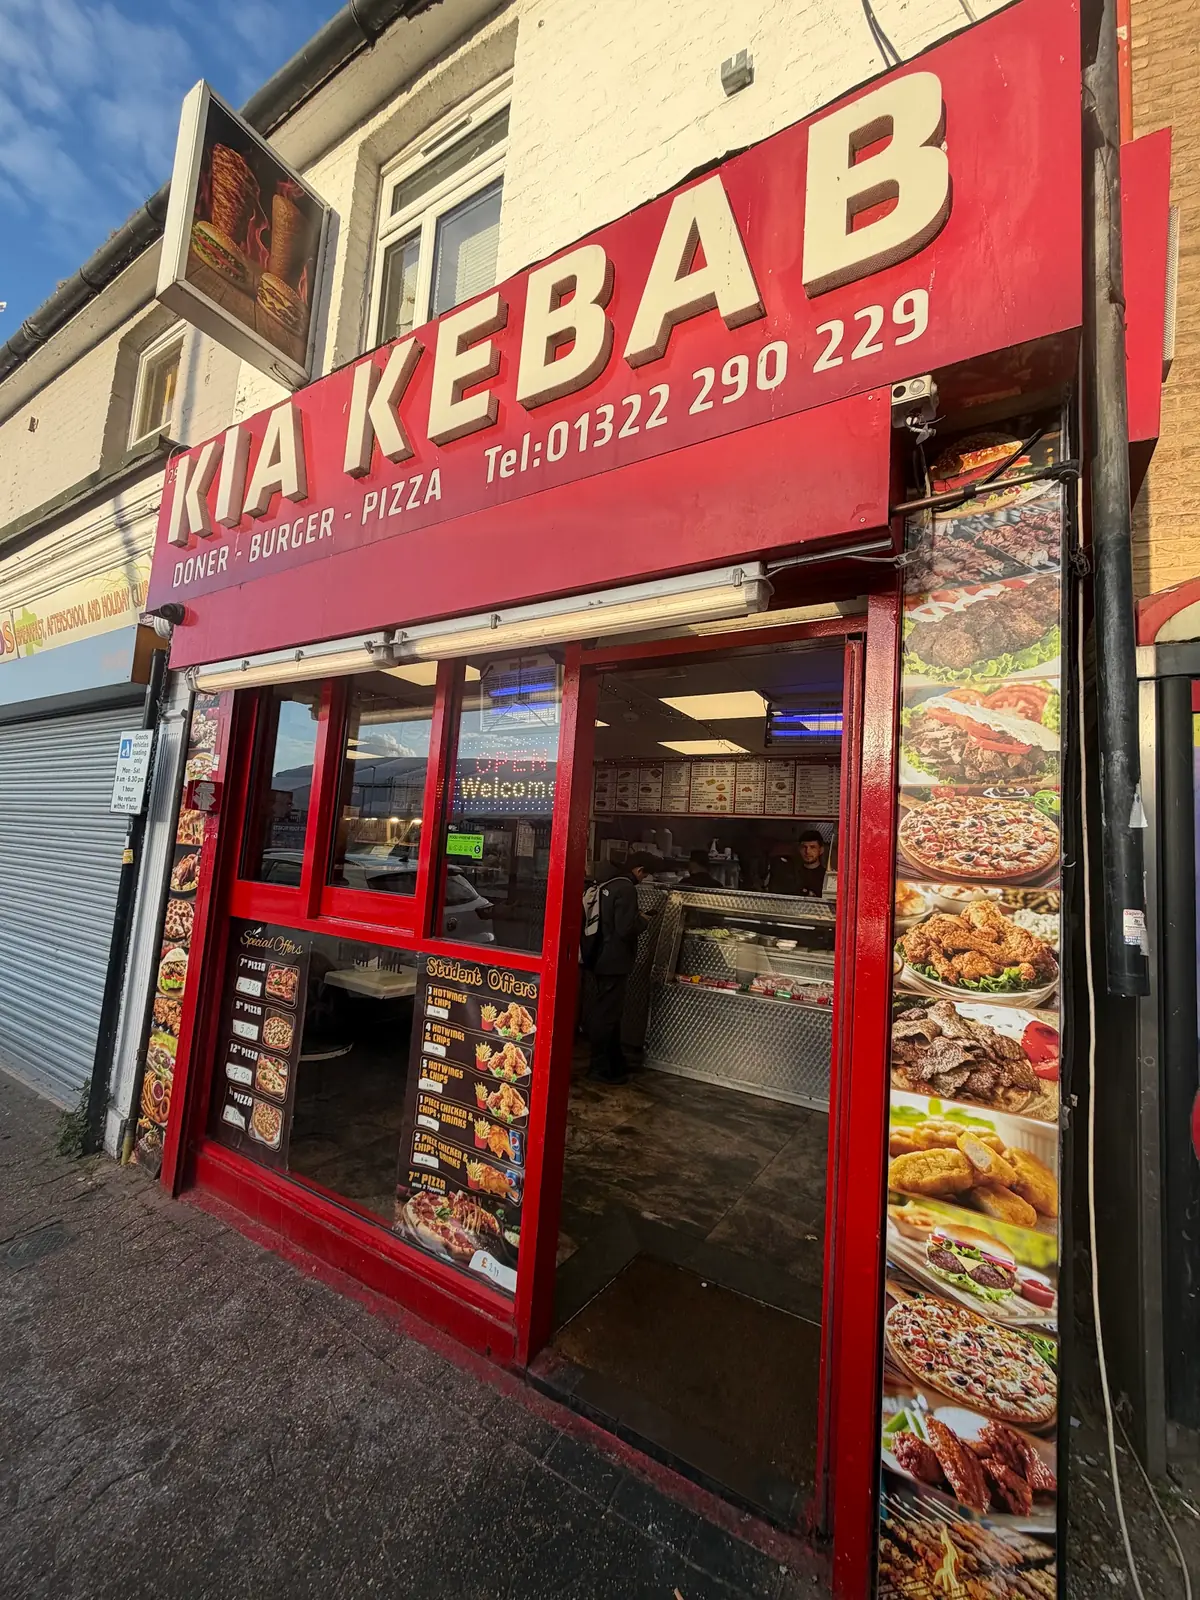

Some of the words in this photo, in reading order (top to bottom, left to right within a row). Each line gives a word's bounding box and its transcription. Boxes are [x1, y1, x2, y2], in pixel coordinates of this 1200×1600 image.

[168, 402, 304, 546] KIA
[343, 71, 952, 477] KEBAB
[484, 383, 670, 484] Tel:01322
[688, 340, 787, 415] 290
[812, 288, 930, 373] 229
[172, 546, 229, 588] DONER
[248, 507, 335, 563] BURGER
[361, 468, 442, 525] PIZZA
[87, 598, 101, 623] AND
[101, 587, 130, 618] HOLIDAY
[476, 749, 548, 773] OPEN
[462, 777, 556, 798] Welcome
[240, 929, 273, 948] Special
[273, 936, 303, 956] Offers
[239, 958, 248, 967] 7"
[248, 960, 266, 972] PIZZA
[426, 957, 482, 986] Student
[487, 969, 538, 999] Offers
[428, 986, 432, 995] 3
[433, 988, 468, 1004] HOTWINGS
[428, 996, 434, 1005] &
[434, 997, 452, 1010] CHIPS
[244, 1004, 262, 1016] PIZZA
[425, 1022, 432, 1032] 4
[432, 1024, 465, 1042] HOTWINGS
[425, 1032, 432, 1041] &
[432, 1034, 451, 1046] CHIPS
[230, 1043, 240, 1053] 12"
[242, 1046, 258, 1061] PIZZA
[422, 1058, 428, 1068] 5
[428, 1060, 464, 1080] HOTWINGS
[422, 1069, 428, 1078] &
[429, 1070, 449, 1085] CHIPS
[234, 1092, 253, 1107] PIZZA
[419, 1094, 424, 1104] 1
[424, 1096, 440, 1110] PIECE
[440, 1102, 468, 1120] CHICKEN
[468, 1112, 474, 1122] &
[419, 1104, 437, 1117] CHIPS
[442, 1113, 467, 1130] DRINKS
[414, 1132, 421, 1142] 2
[421, 1134, 438, 1148] PIECE
[438, 1142, 462, 1160] CHICKEN
[414, 1142, 435, 1155] CHIPS
[408, 1170, 420, 1182] 7"
[421, 1173, 446, 1190] PIZZA
[481, 1256, 488, 1268] £
